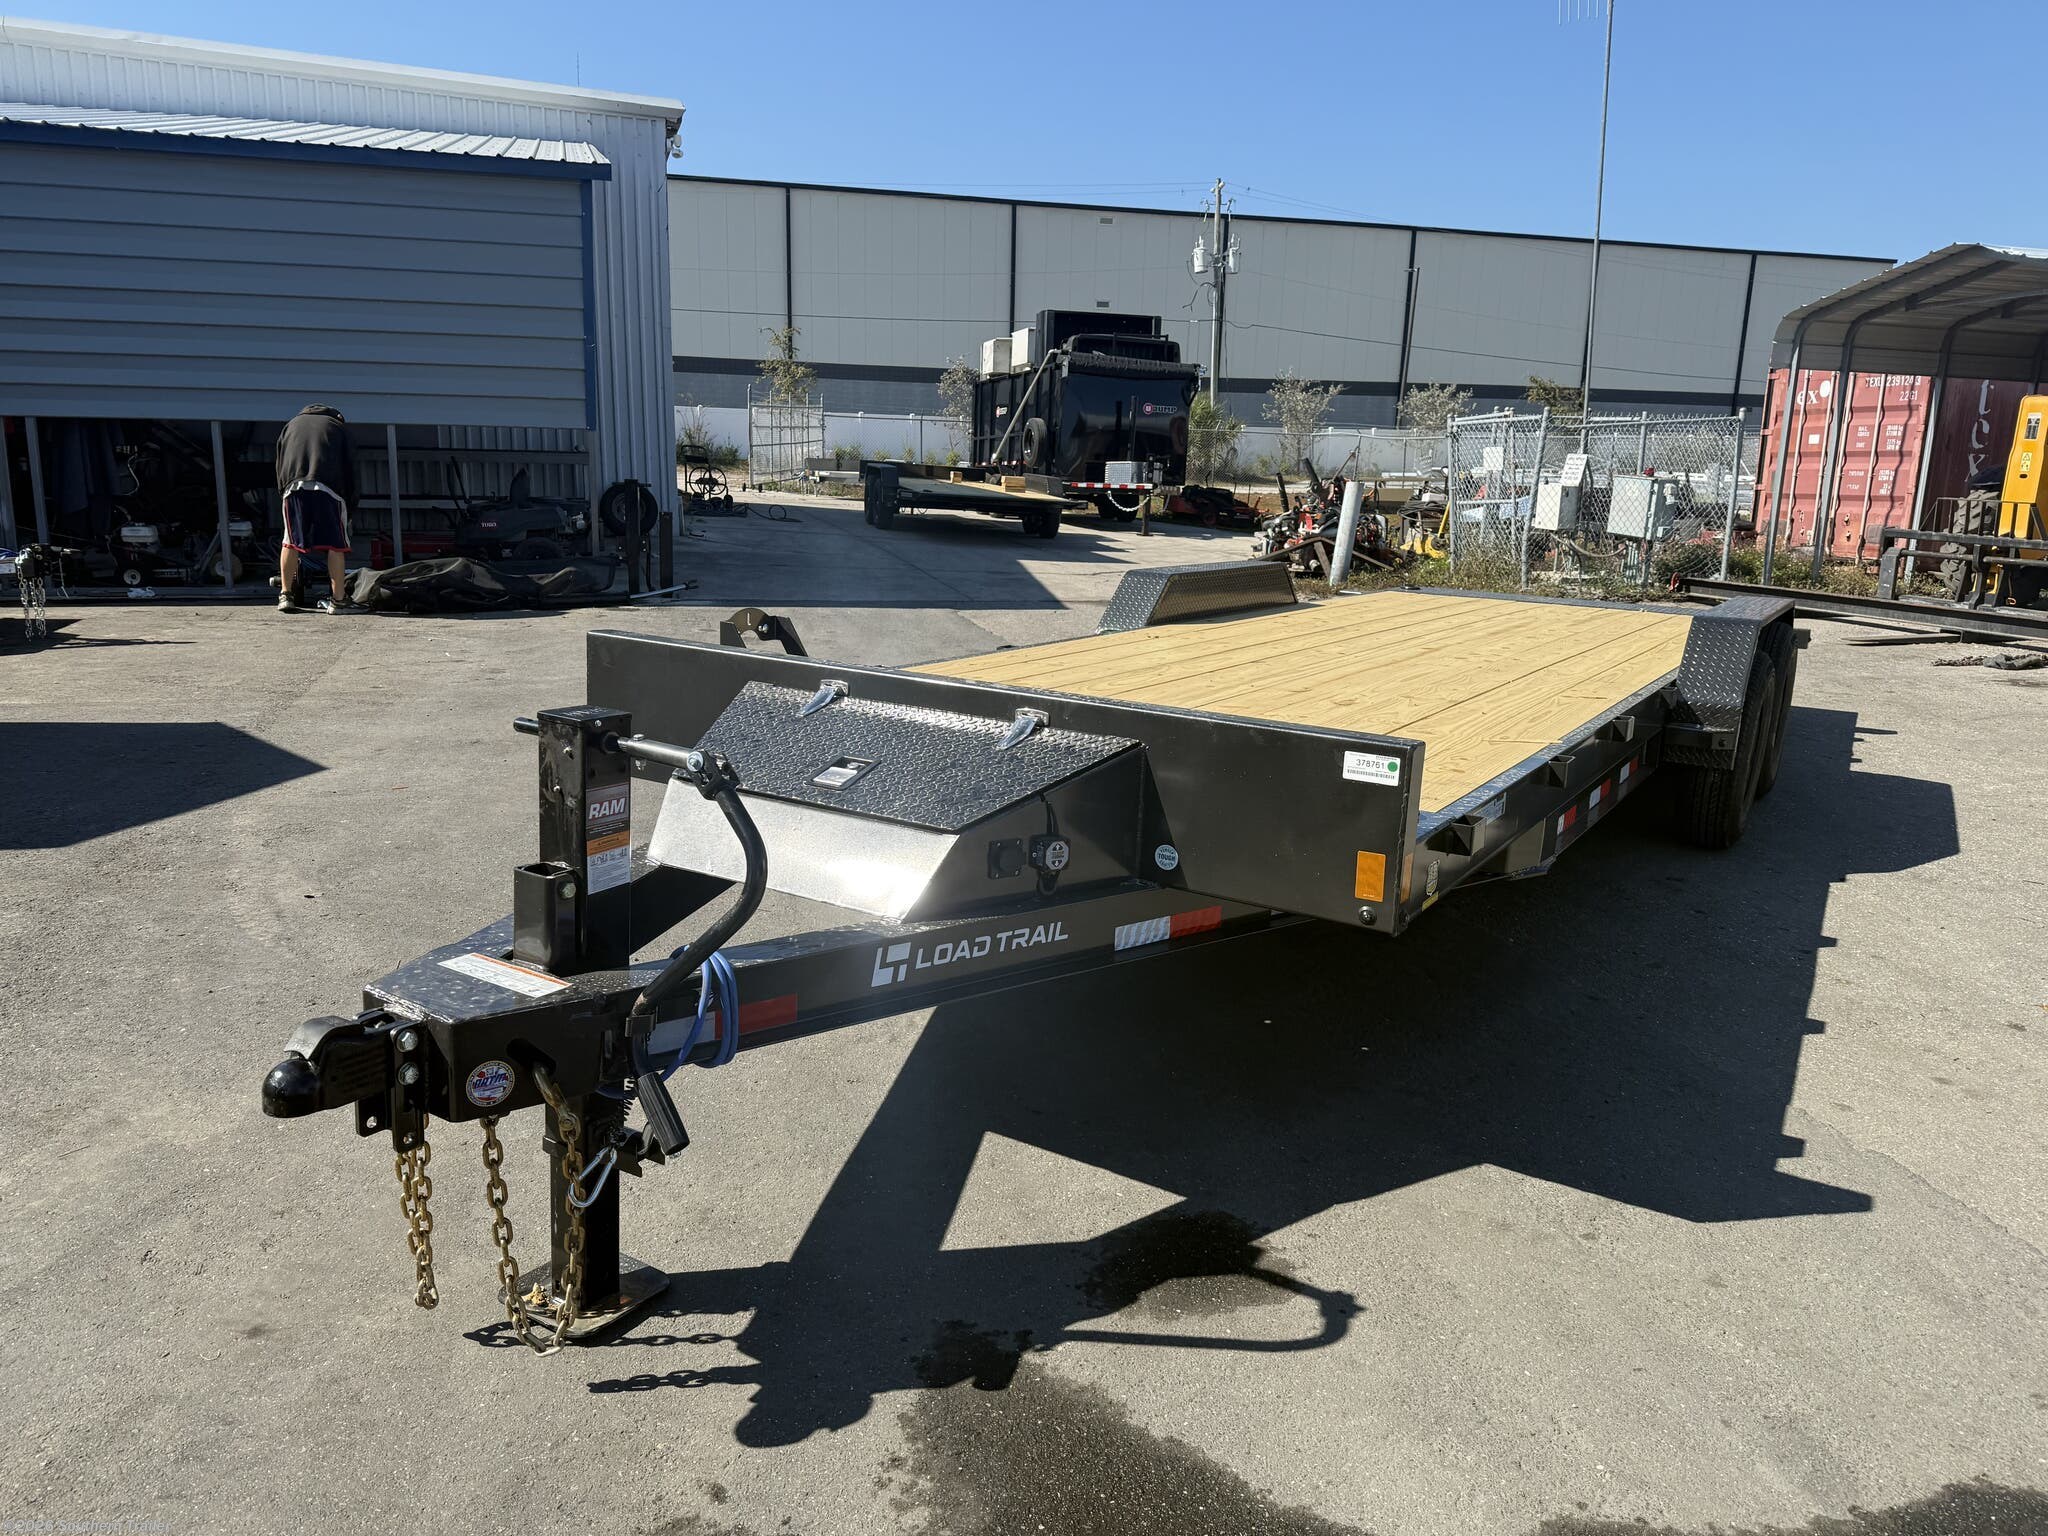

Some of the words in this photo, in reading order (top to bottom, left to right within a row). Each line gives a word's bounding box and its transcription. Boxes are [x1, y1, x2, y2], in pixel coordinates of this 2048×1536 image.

[1356, 758, 1385, 769] 378761
[588, 797, 626, 820] RAM
[915, 935, 991, 970] LOAD
[997, 921, 1069, 952] TRAIL
